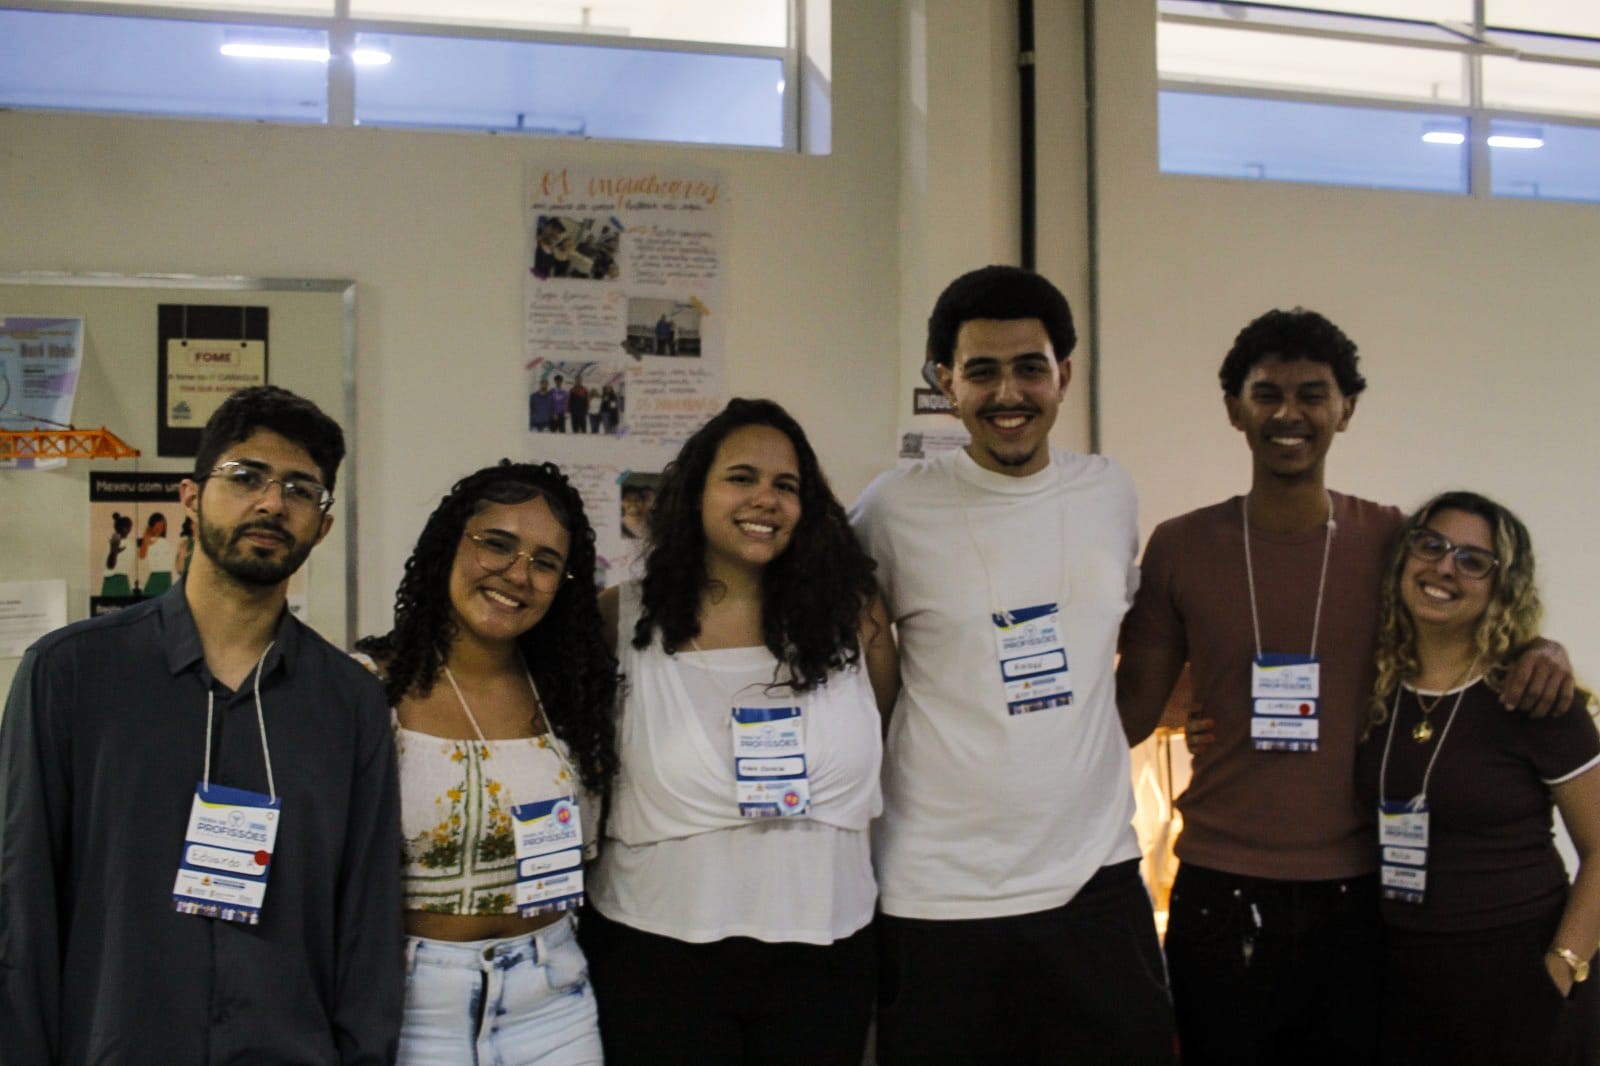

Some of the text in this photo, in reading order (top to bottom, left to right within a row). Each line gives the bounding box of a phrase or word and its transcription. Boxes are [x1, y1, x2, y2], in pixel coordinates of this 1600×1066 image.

[195, 352, 231, 363] FOME
[96, 481, 135, 492] Mexeu
[138, 483, 163, 492] com
